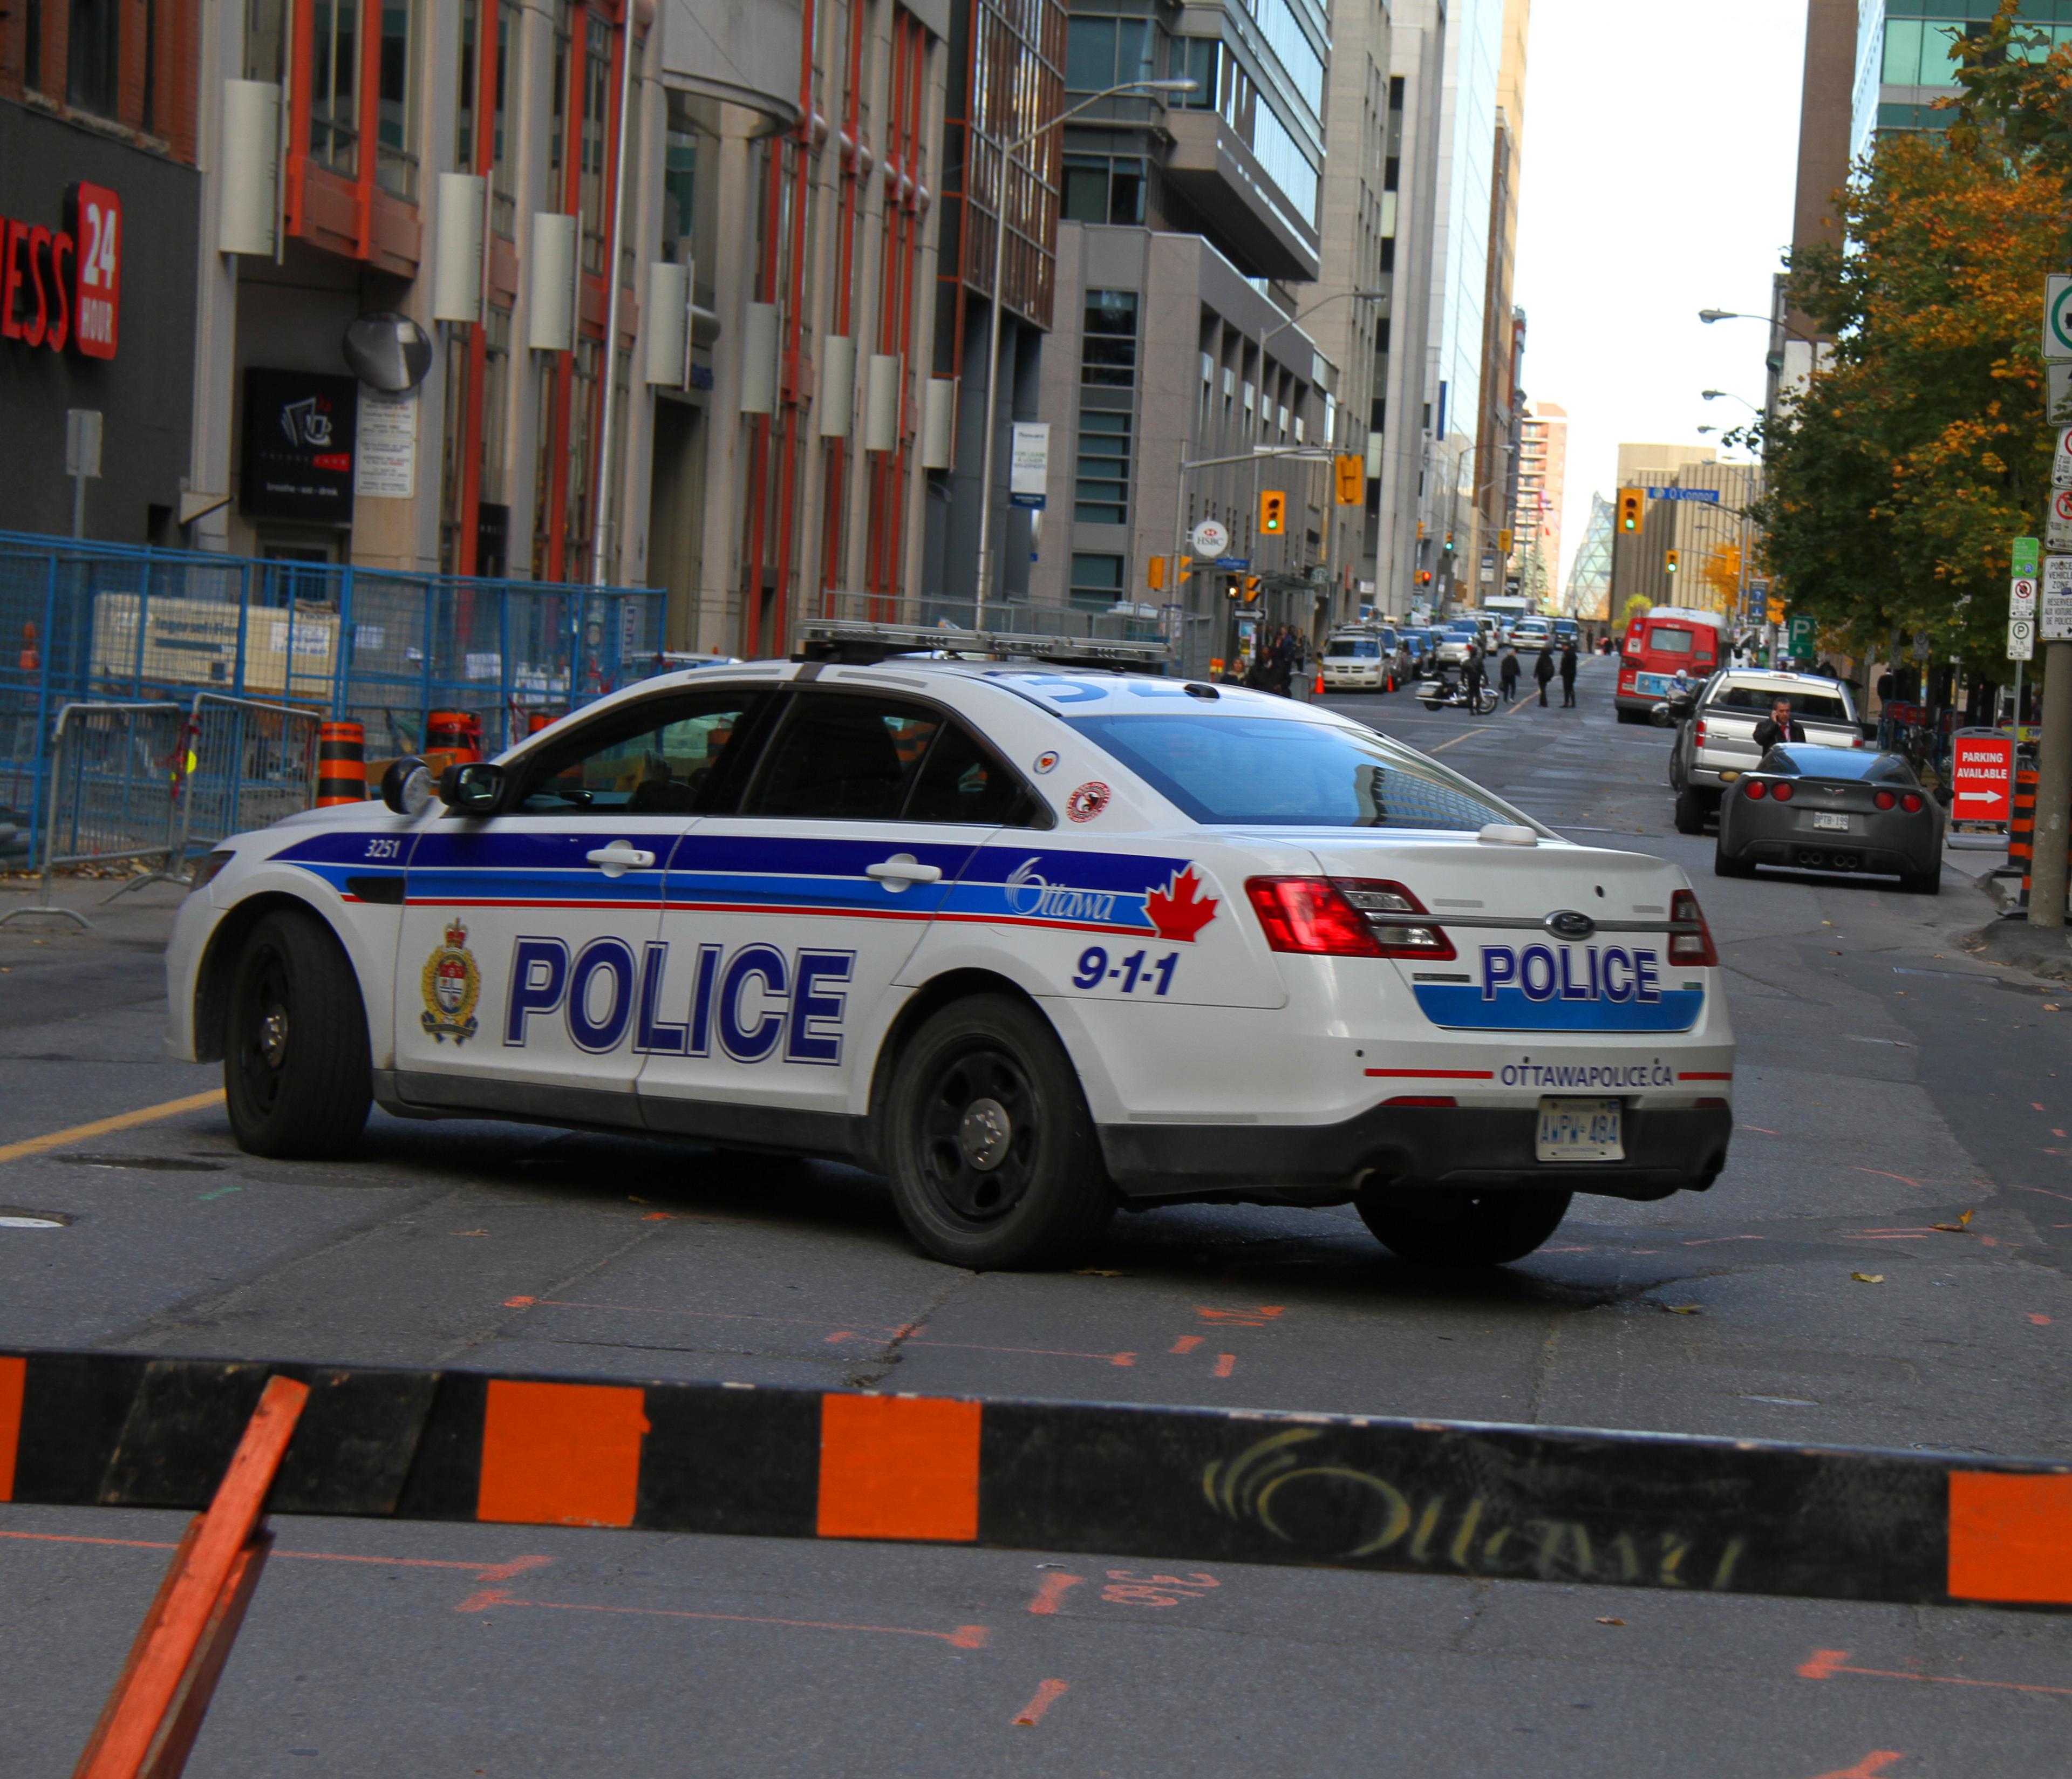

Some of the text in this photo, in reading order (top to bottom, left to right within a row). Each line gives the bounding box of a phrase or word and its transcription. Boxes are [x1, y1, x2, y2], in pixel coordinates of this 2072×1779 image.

[83, 203, 116, 289] 24
[0, 214, 73, 352] ESS
[80, 296, 113, 344] HOUR
[1197, 536, 1224, 546] HSBC
[2050, 561, 2072, 570] POLICE
[2052, 581, 2069, 589] ZONE
[1957, 768, 2007, 779] AVAILABLE
[1962, 752, 2003, 763] PARKING
[364, 839, 401, 858] 3251
[1004, 856, 1116, 920] Ottawa
[1072, 946, 1180, 996] 9-1-1
[1479, 943, 1662, 1004] POLICE
[502, 935, 857, 1067] POLICE
[1501, 1065, 1673, 1087] OTTAWAPOLICE.CA
